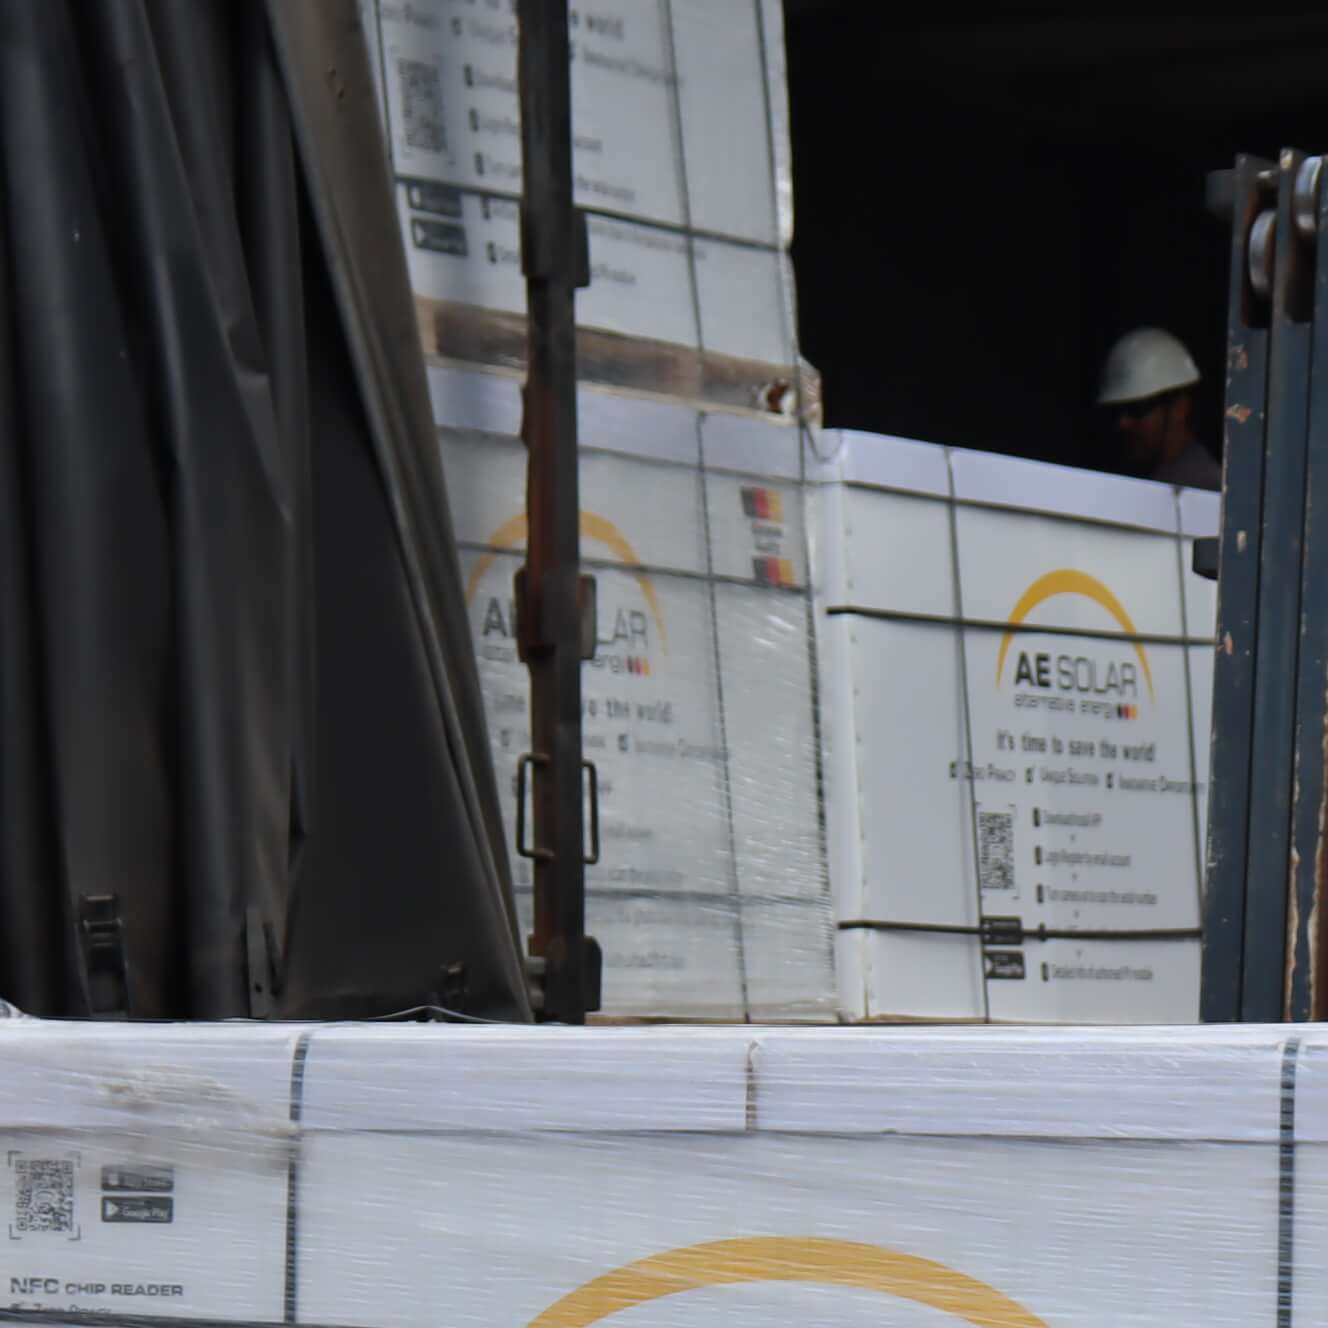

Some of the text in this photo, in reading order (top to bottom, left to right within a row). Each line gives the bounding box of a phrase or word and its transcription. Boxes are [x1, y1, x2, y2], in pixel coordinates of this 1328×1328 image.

[1014, 651, 1137, 697] AE SOLAR
[10, 1277, 184, 1297] NFC CHIP READER
